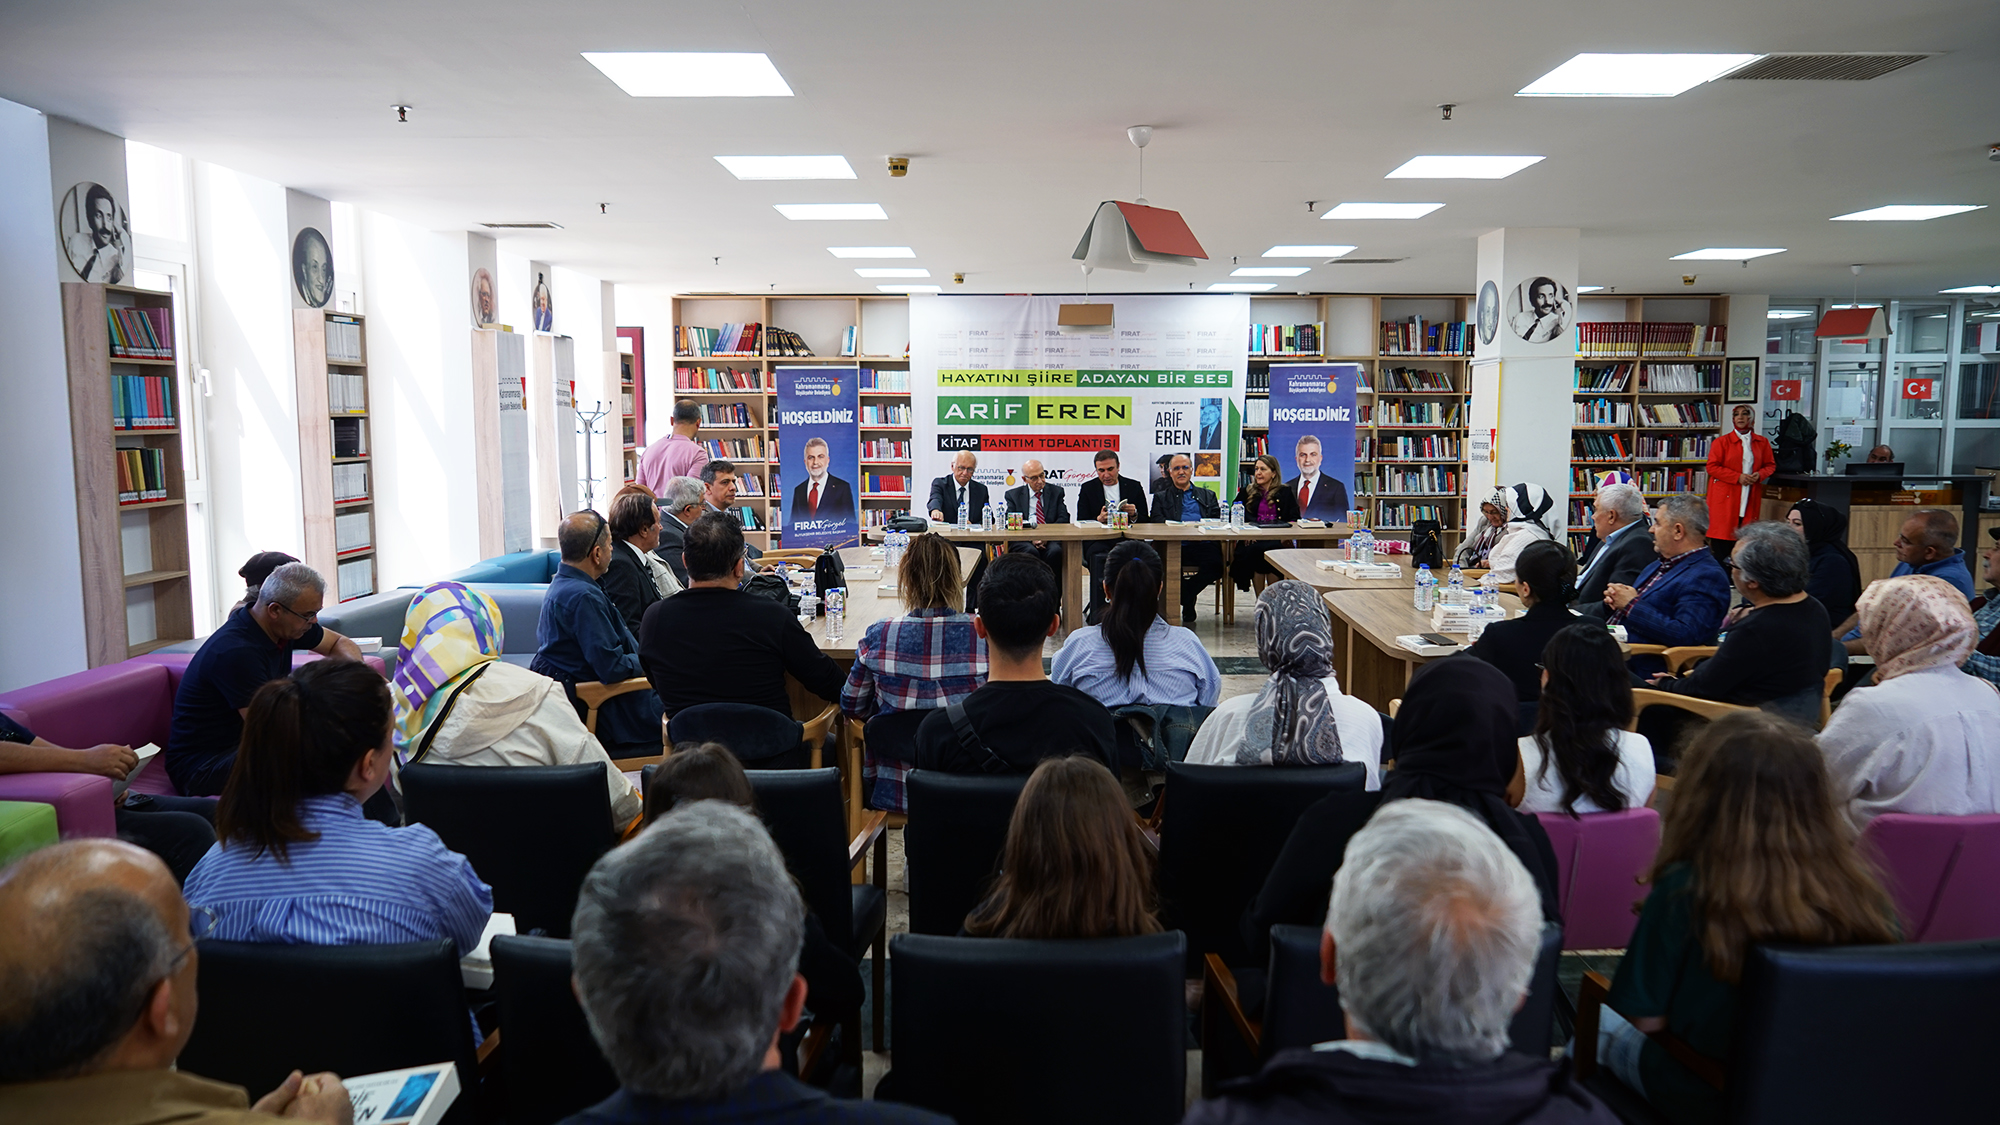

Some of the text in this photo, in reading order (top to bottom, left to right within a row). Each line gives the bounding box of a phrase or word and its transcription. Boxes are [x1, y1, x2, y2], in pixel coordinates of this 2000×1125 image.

[942, 371, 1228, 386] HAYATINI ŞİİRE ADAYAN BİR SES
[782, 408, 854, 426] HOŞGELDİNİZ
[944, 398, 1126, 420] ARİF EREN
[1273, 406, 1350, 424] HOŞGELDİNİZ
[1155, 408, 1183, 428] ARİF
[941, 436, 1116, 448] KİTAP TANITIM TOPLANTISI
[1156, 430, 1192, 446] EREN
[794, 520, 823, 531] FIRAT
